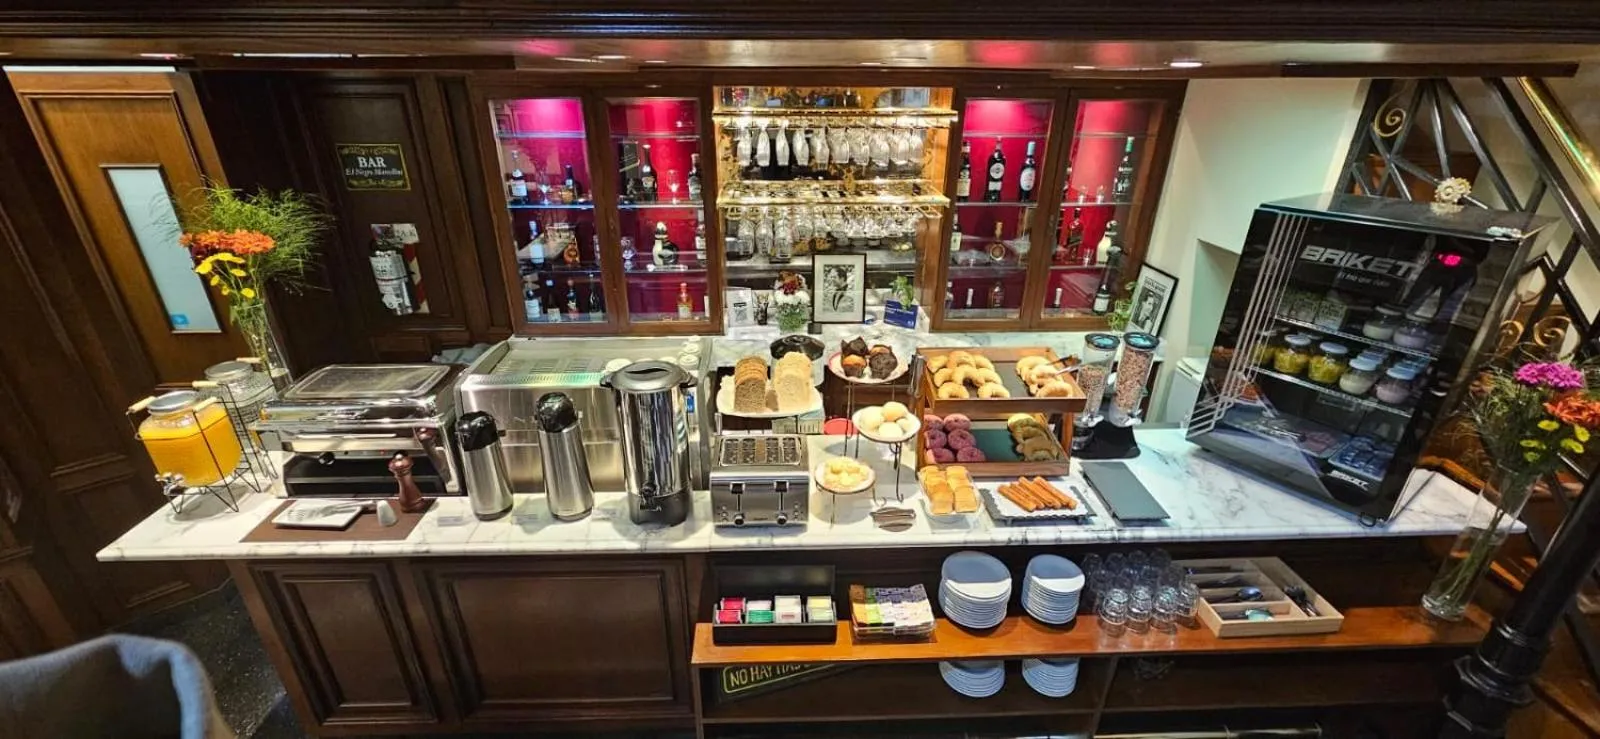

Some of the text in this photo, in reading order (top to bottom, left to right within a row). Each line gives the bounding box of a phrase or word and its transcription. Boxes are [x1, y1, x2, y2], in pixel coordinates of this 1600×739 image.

[357, 157, 387, 168] BAR
[1300, 244, 1419, 277] BRIKET
[730, 668, 748, 687] NO
[750, 665, 772, 682] HAY
